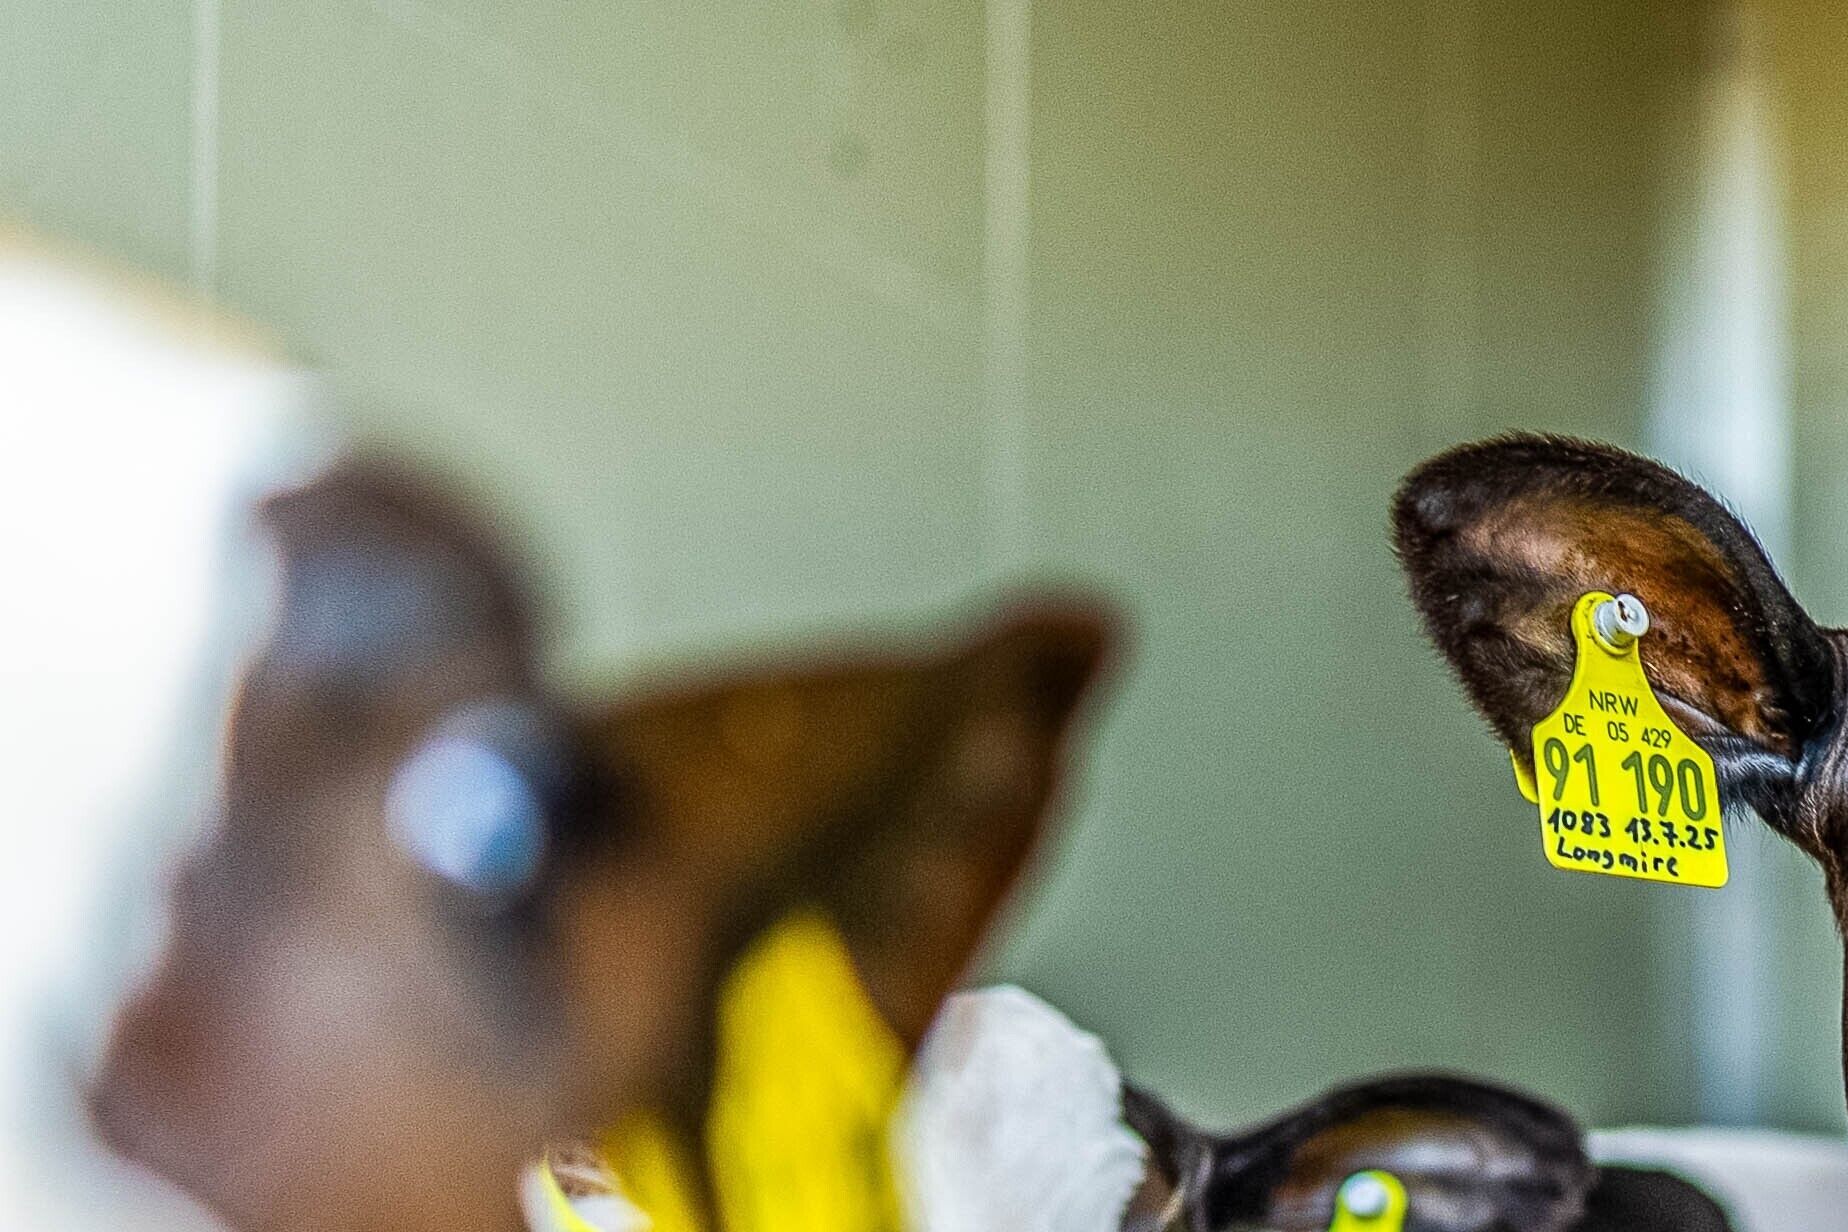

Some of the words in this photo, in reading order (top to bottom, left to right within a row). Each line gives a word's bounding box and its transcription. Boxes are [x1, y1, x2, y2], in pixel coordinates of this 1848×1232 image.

[1589, 689, 1639, 717] NRW
[1564, 713, 1587, 736] DE
[1607, 721, 1630, 743] 05
[1641, 727, 1673, 749] 429
[1543, 737, 1600, 807] 91
[1621, 750, 1707, 822] 190
[1547, 807, 1612, 838] 1083
[1625, 817, 1719, 851] 13.7.25
[1557, 837, 1679, 876] Longmire
